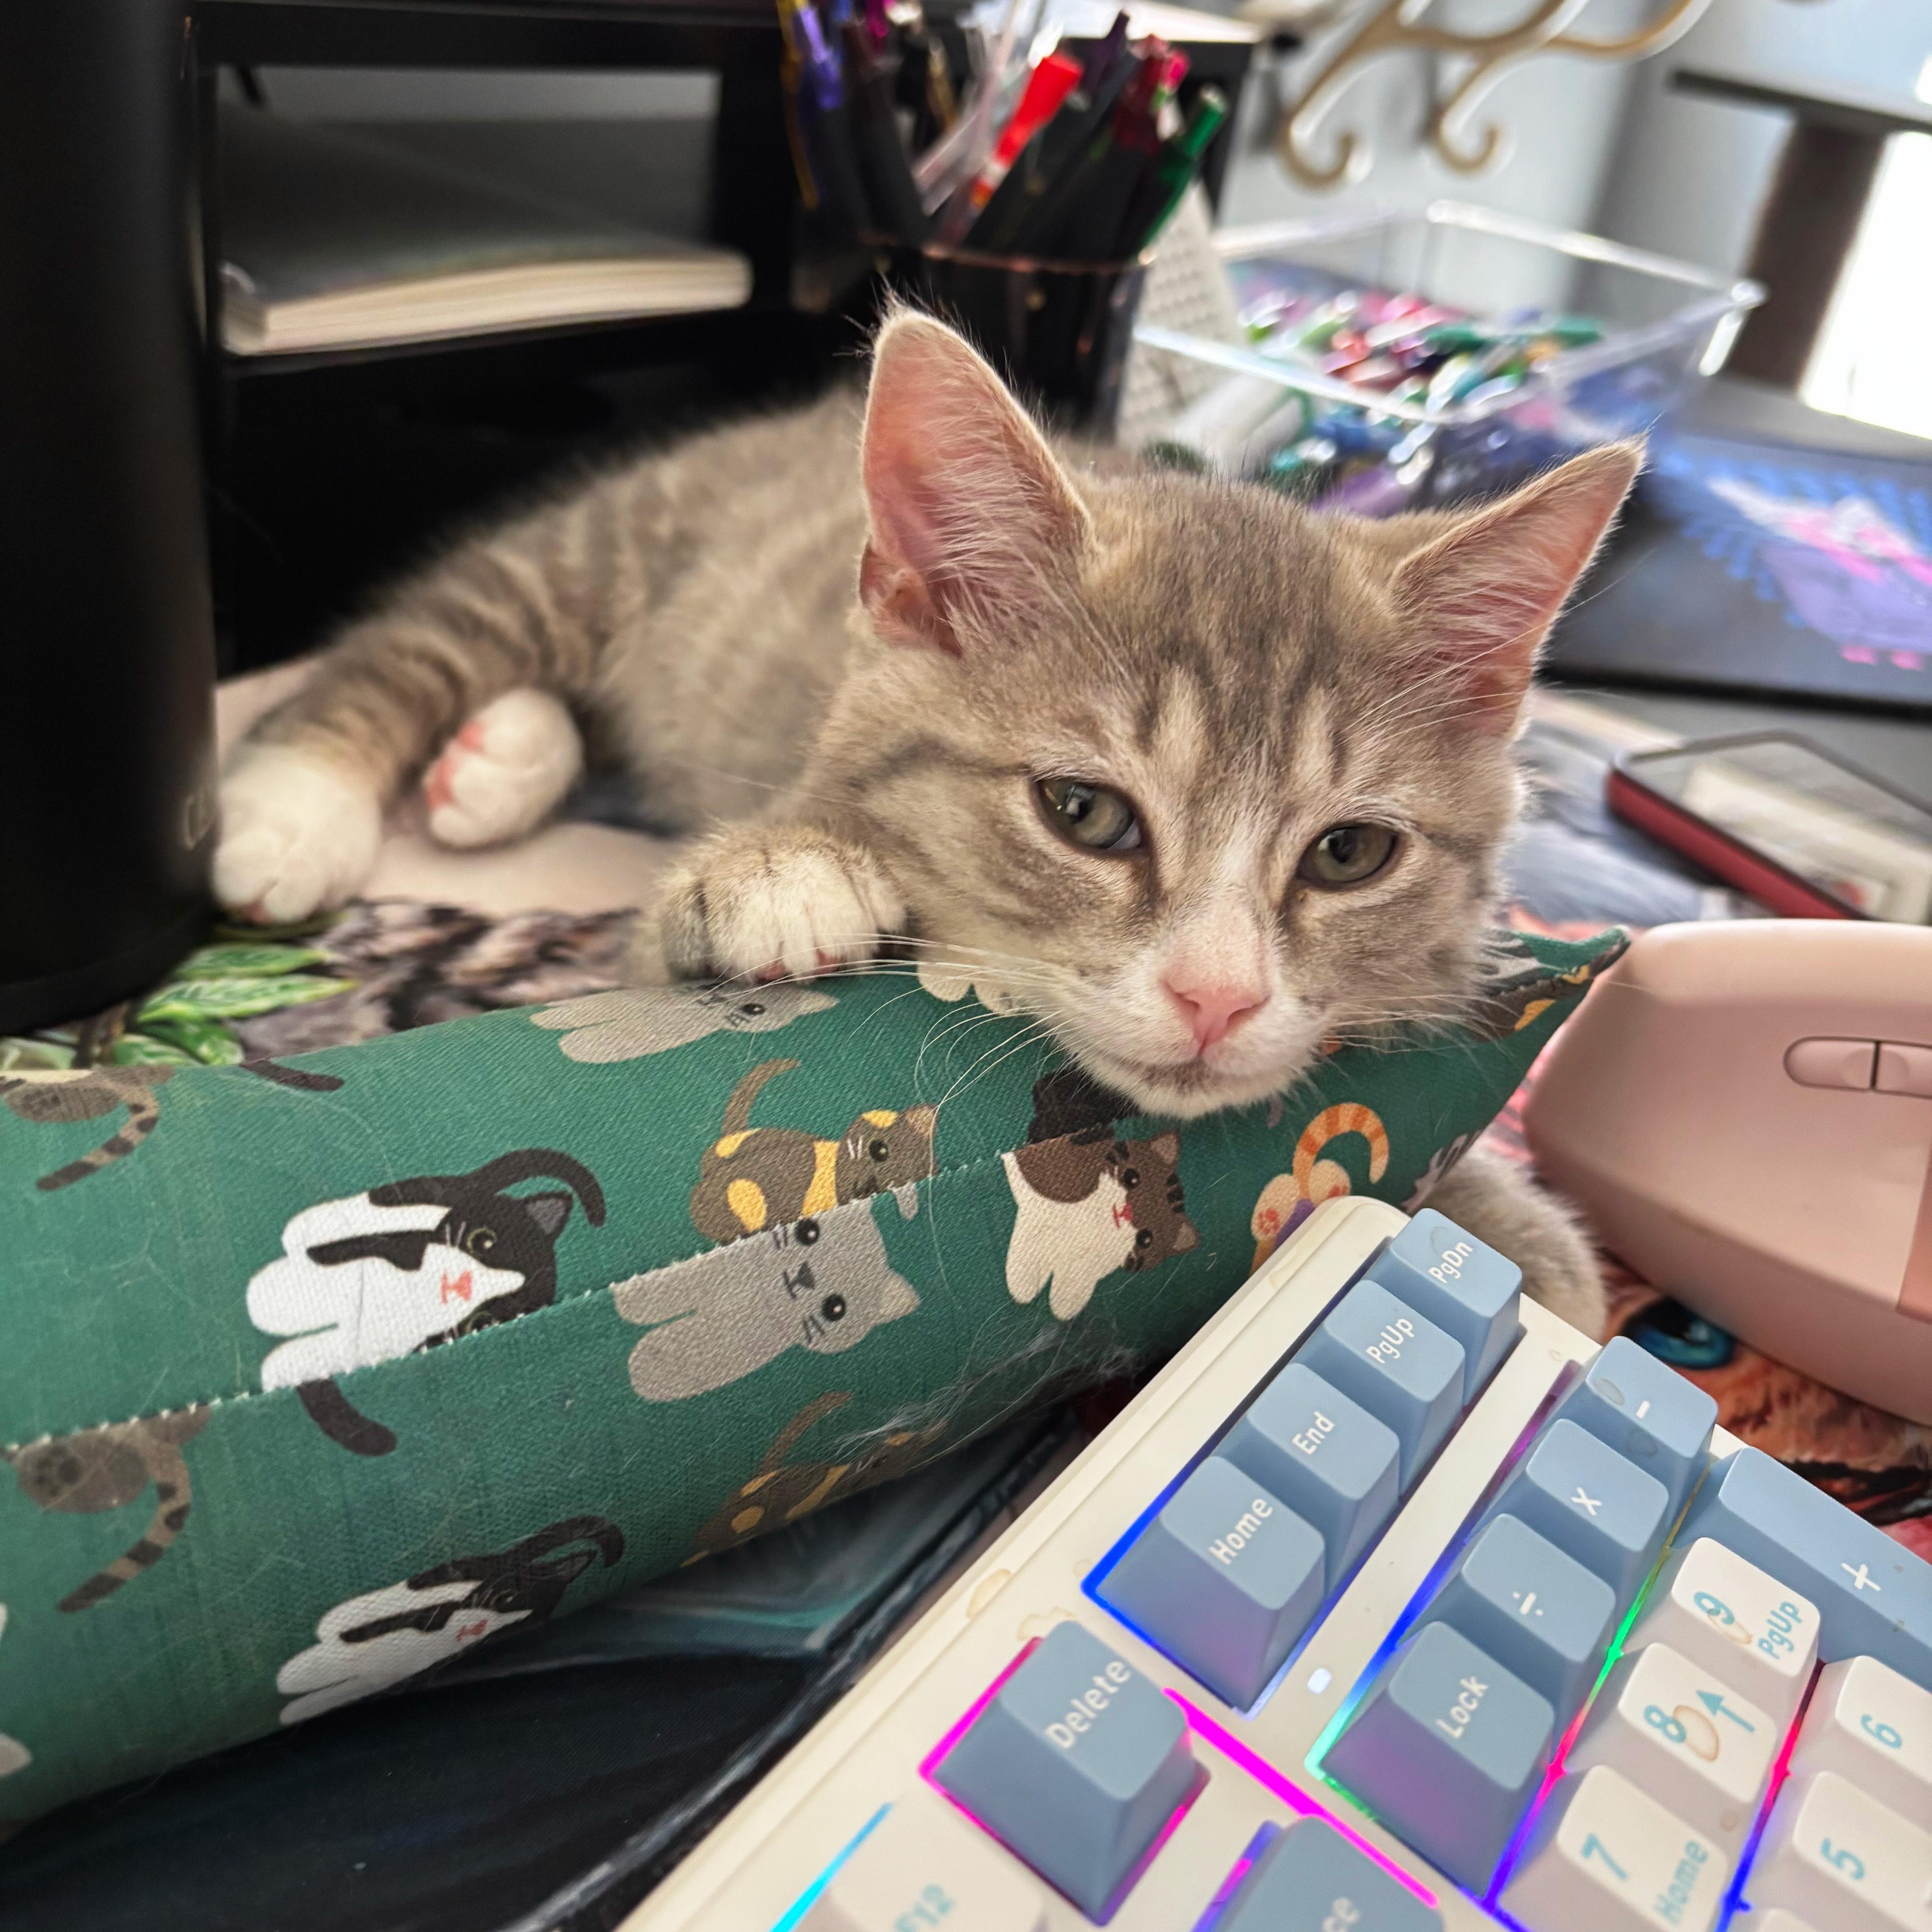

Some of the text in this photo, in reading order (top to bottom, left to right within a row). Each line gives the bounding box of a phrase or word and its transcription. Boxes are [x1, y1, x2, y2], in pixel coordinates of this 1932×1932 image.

[1428, 1242, 1473, 1283] PgDn
[1365, 1318, 1415, 1364] PgUp
[1292, 1411, 1335, 1455] End
[1208, 1498, 1273, 1565] Home
[1693, 1591, 1734, 1625] 9
[1757, 1600, 1804, 1659] PgUp
[1044, 1659, 1131, 1749] Delete
[1436, 1676, 1489, 1739] Lock
[1643, 1705, 1686, 1744] 8
[1860, 1714, 1902, 1749] 6
[1581, 1834, 1627, 1880] 7
[1820, 1838, 1865, 1880] 5
[1654, 1840, 1709, 1927] Home
